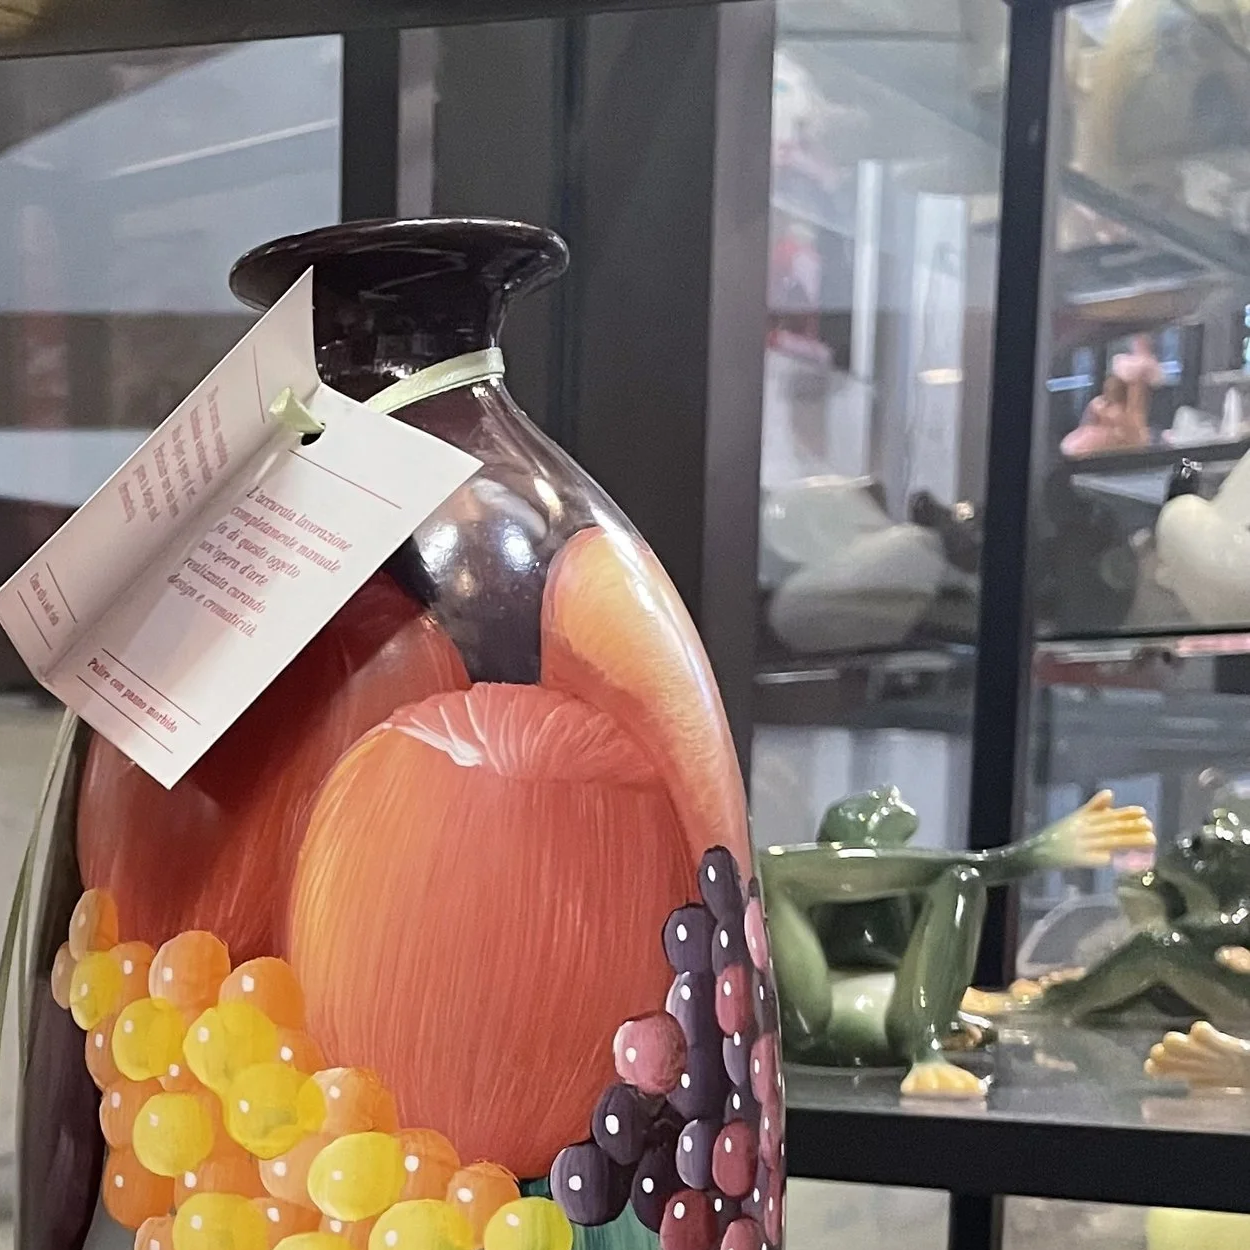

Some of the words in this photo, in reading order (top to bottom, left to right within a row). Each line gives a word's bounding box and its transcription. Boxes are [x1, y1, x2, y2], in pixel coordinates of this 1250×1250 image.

[230, 506, 298, 548] completamente
[296, 543, 342, 573] manuale
[295, 515, 352, 552] lavorazione
[226, 528, 243, 542] di
[237, 536, 268, 560] questo
[265, 555, 300, 579] oggetto
[167, 573, 198, 598] design
[239, 564, 269, 587] d'arte
[227, 586, 268, 614] curando
[146, 707, 178, 733] morbido
